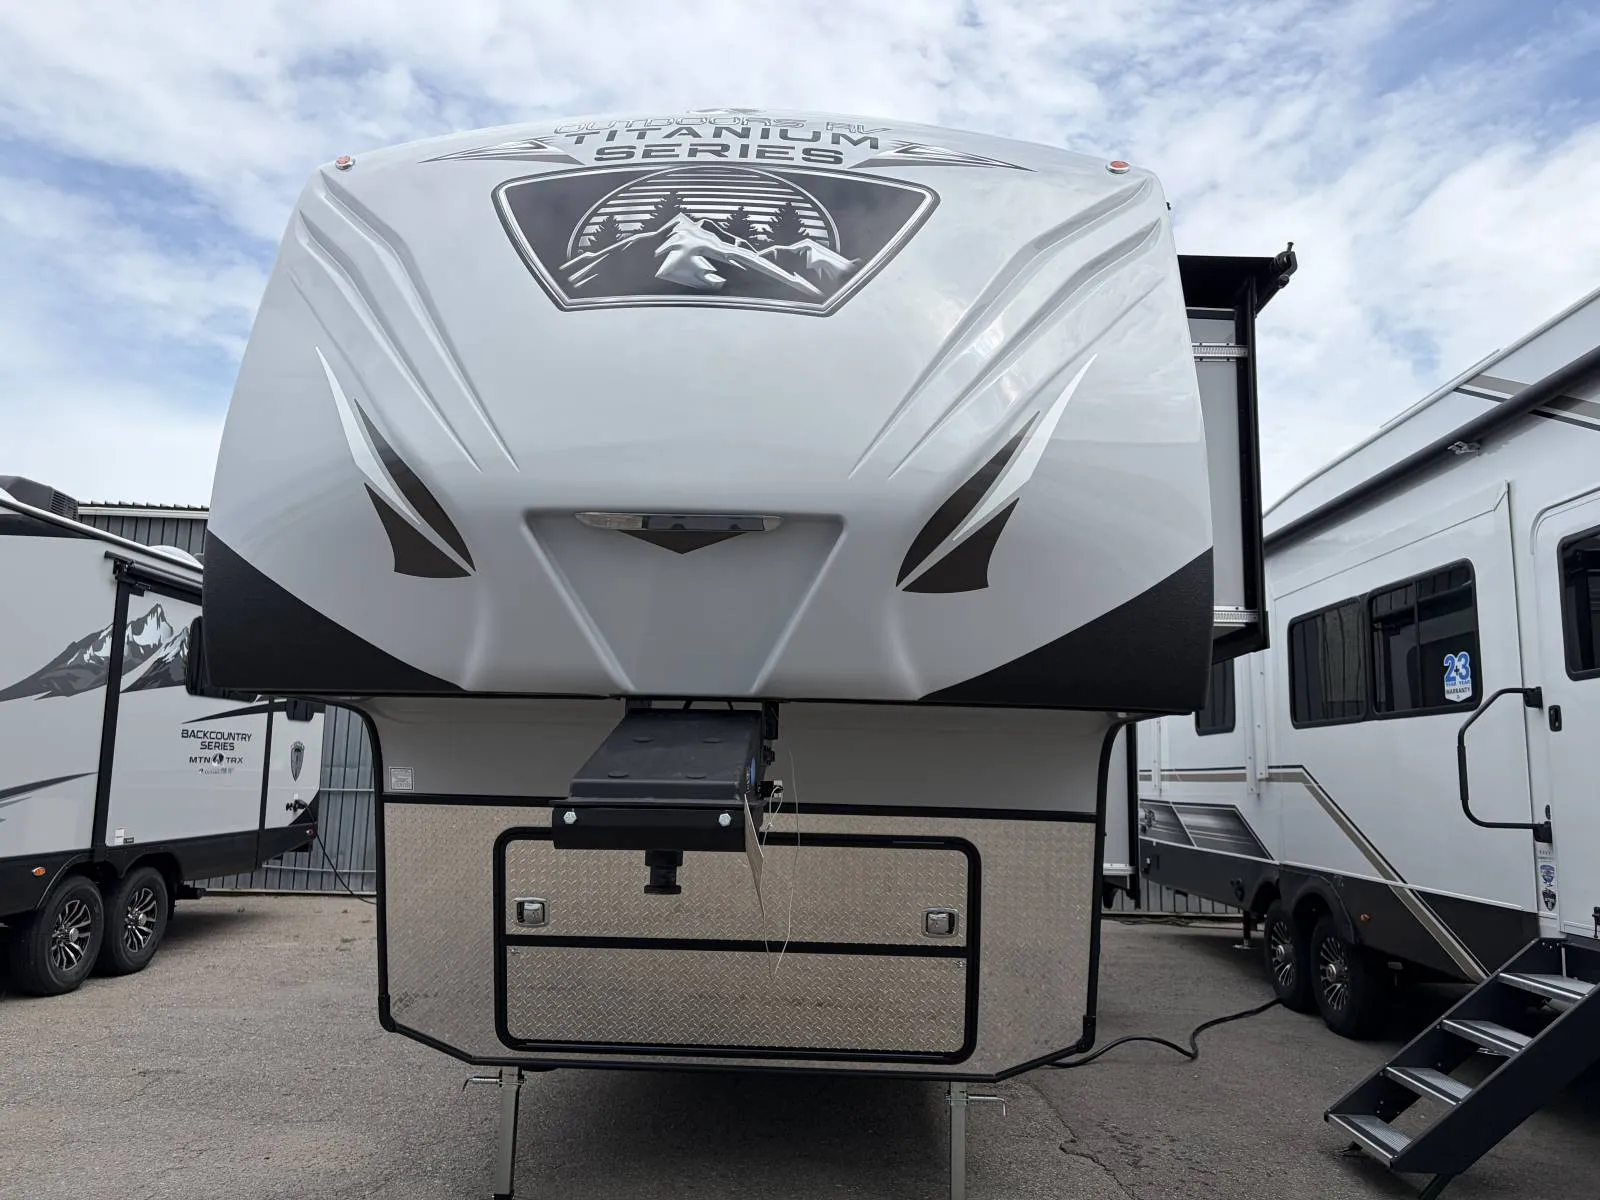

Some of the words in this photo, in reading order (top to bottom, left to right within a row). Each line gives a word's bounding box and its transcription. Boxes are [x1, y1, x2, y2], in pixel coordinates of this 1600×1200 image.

[565, 126, 879, 150] TITANIUM
[594, 145, 844, 164] SERIES
[181, 729, 252, 742] BACKCOUNTRY
[200, 742, 235, 751] SERIES
[189, 756, 211, 764] MTN
